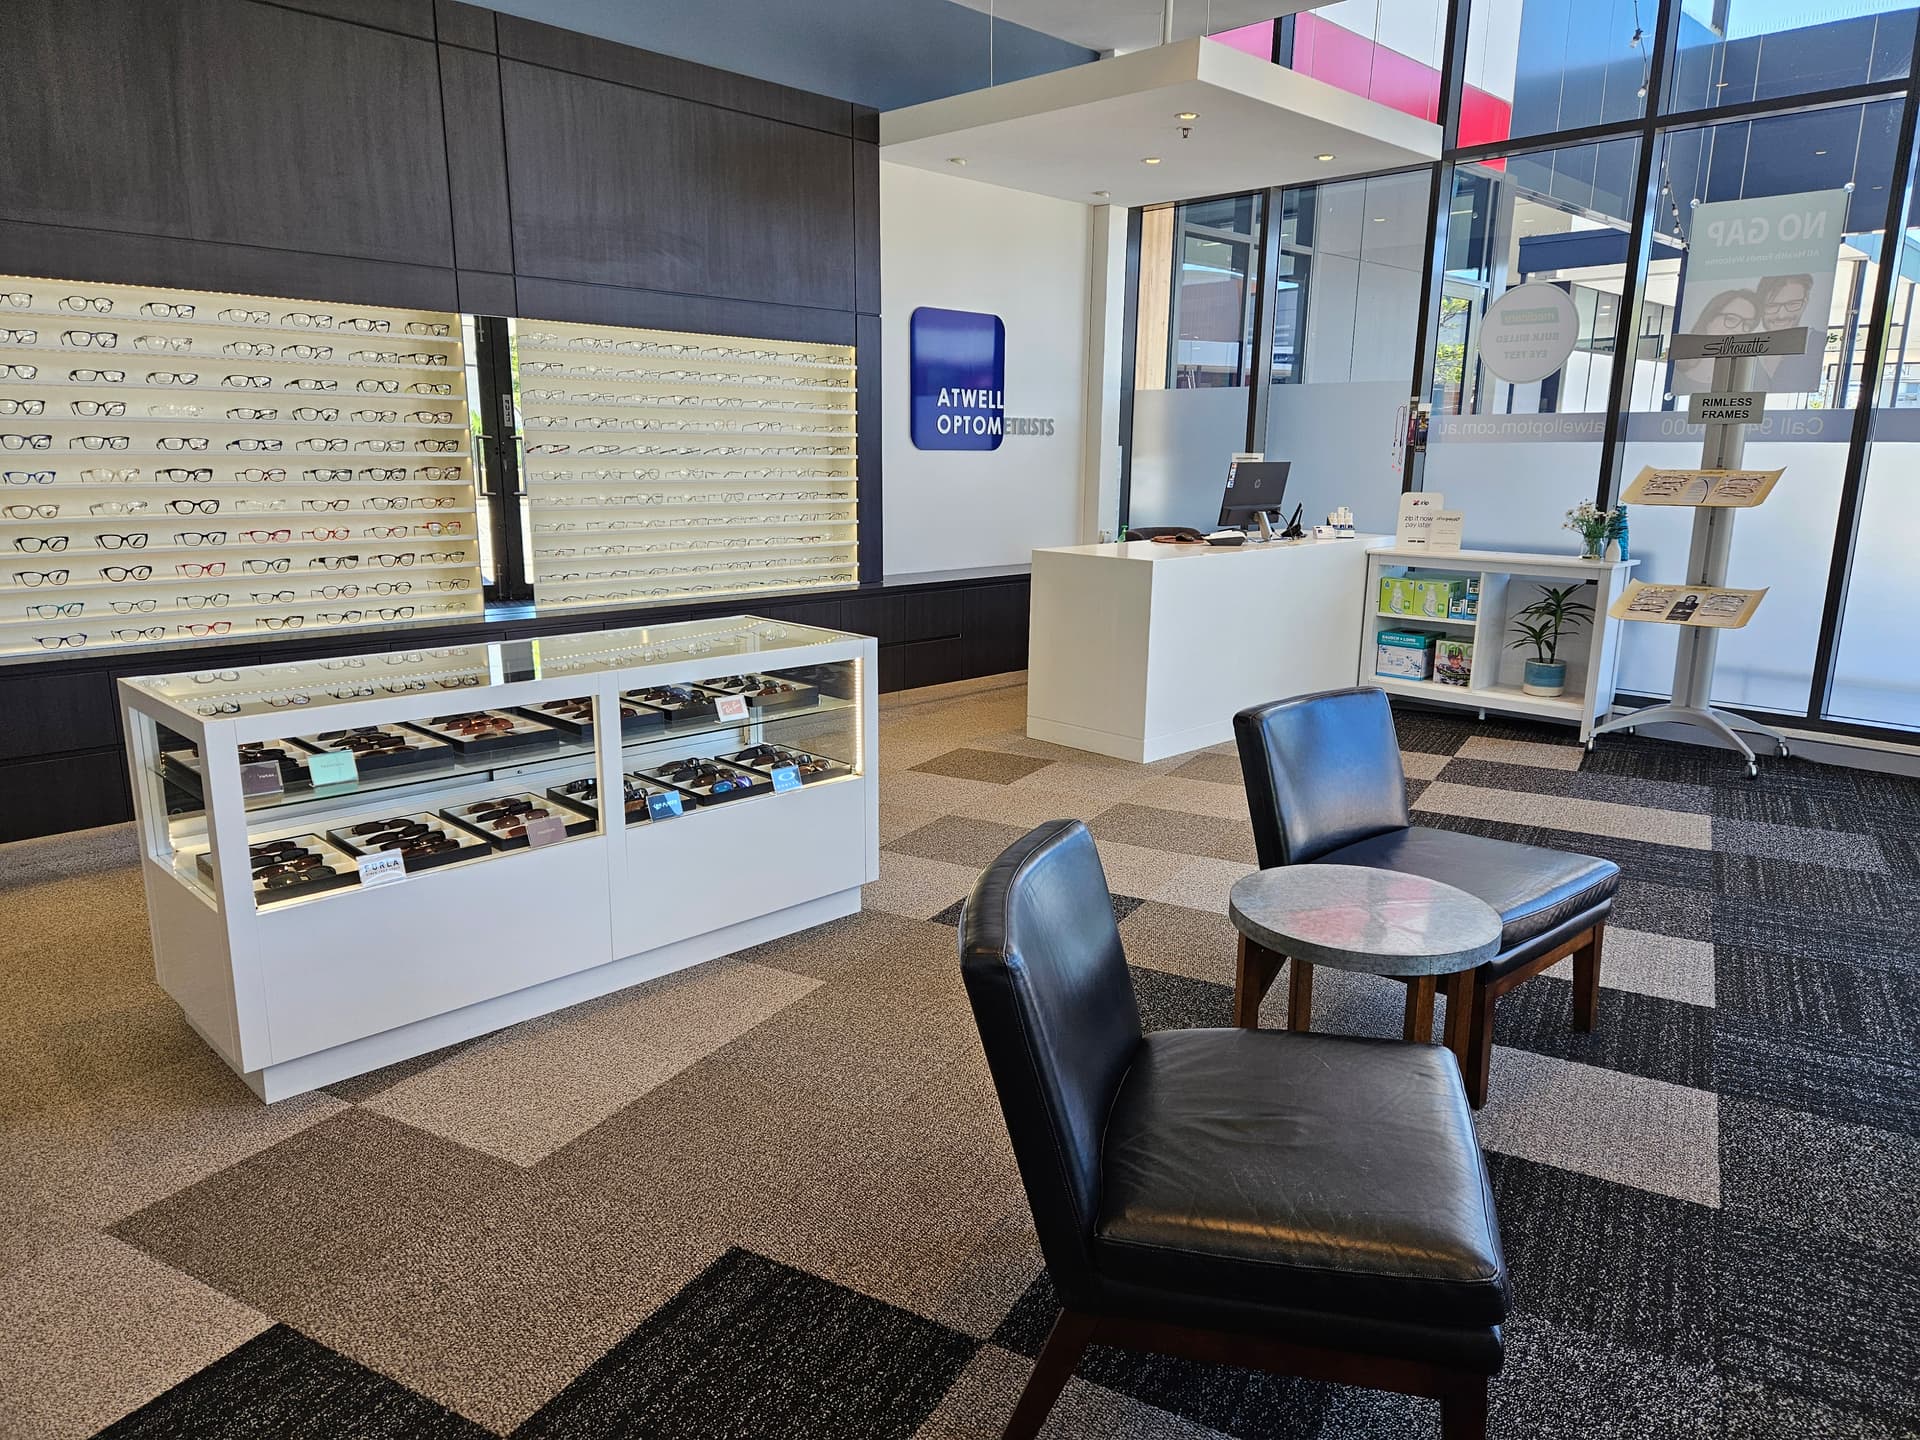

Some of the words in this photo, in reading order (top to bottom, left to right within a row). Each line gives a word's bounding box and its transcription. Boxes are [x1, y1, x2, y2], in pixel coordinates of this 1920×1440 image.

[1701, 336, 1770, 356] Silhouette
[937, 387, 1005, 409] ATWELL
[1702, 397, 1753, 407] RIMLESS
[1701, 409, 1750, 419] FRAMES
[936, 414, 1054, 436] OPTOMETRISTS
[364, 860, 400, 873] FURLA
